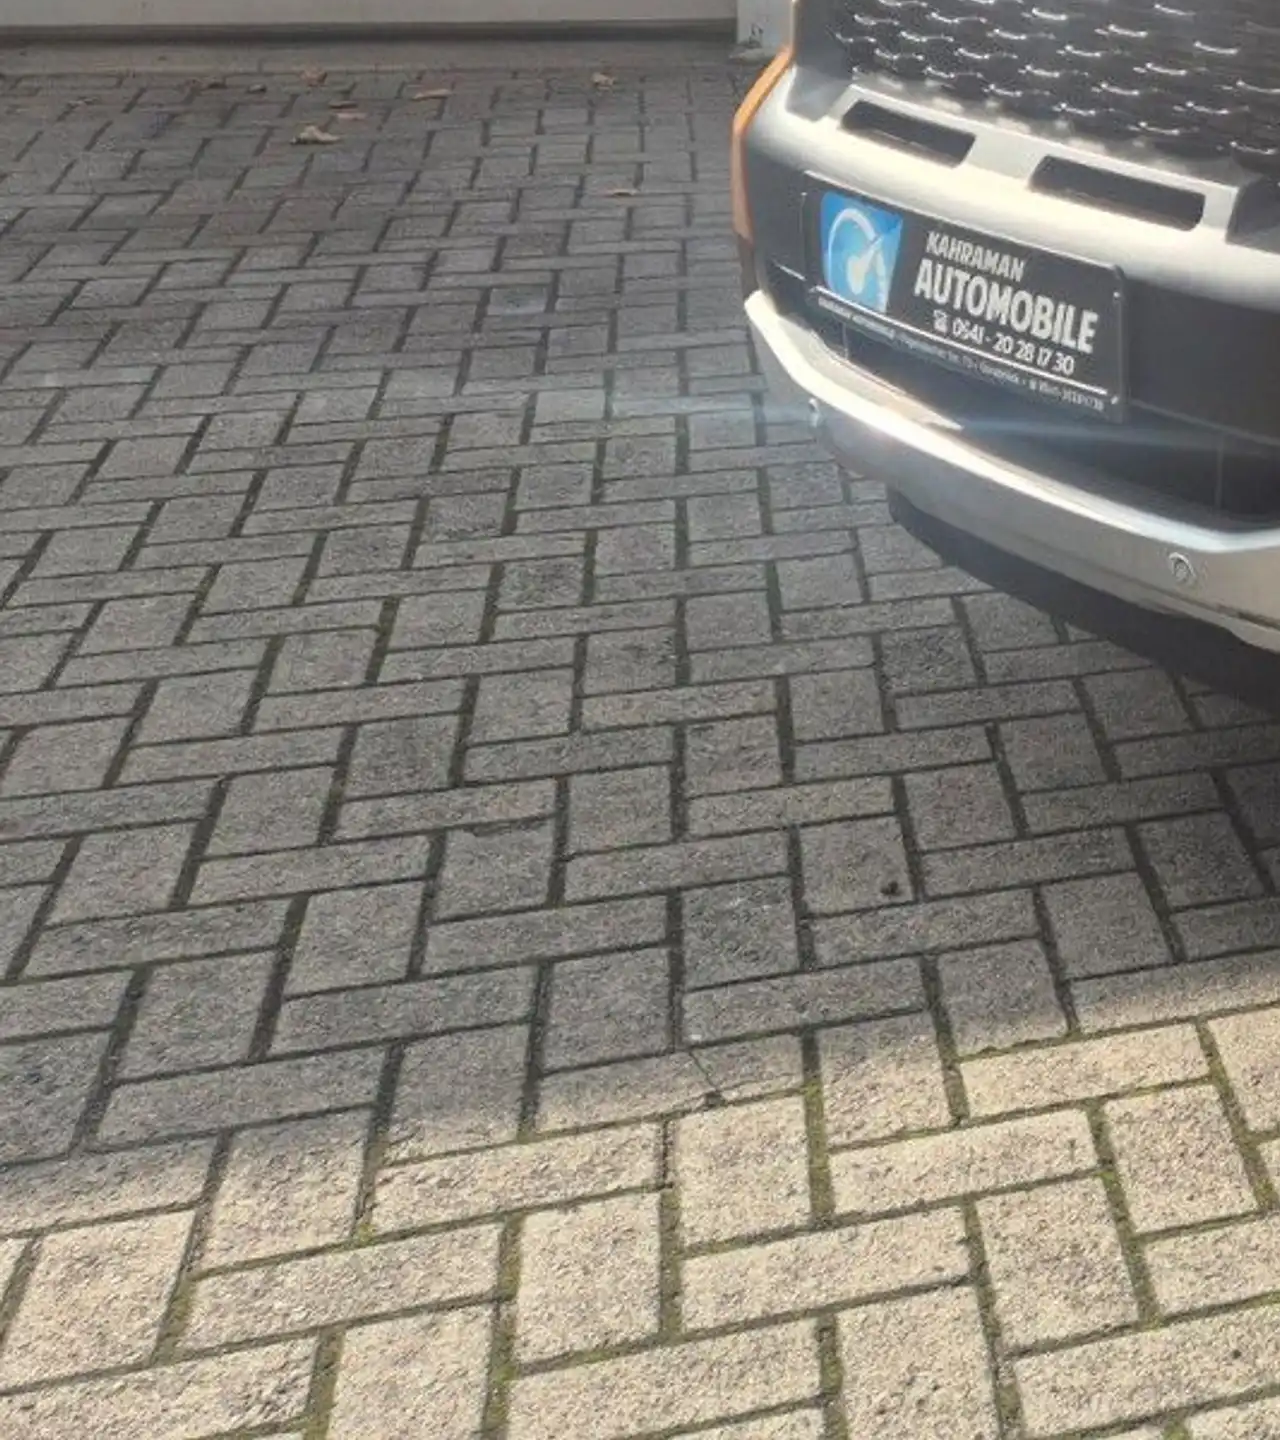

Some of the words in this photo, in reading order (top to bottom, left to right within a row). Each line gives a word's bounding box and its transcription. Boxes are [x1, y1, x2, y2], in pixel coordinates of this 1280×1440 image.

[926, 230, 1025, 283] KAHRAMAN
[913, 257, 1099, 354] AUTOMOBILE
[992, 331, 1014, 354] 20
[1015, 339, 1036, 362] 28
[1051, 352, 1075, 376] 30
